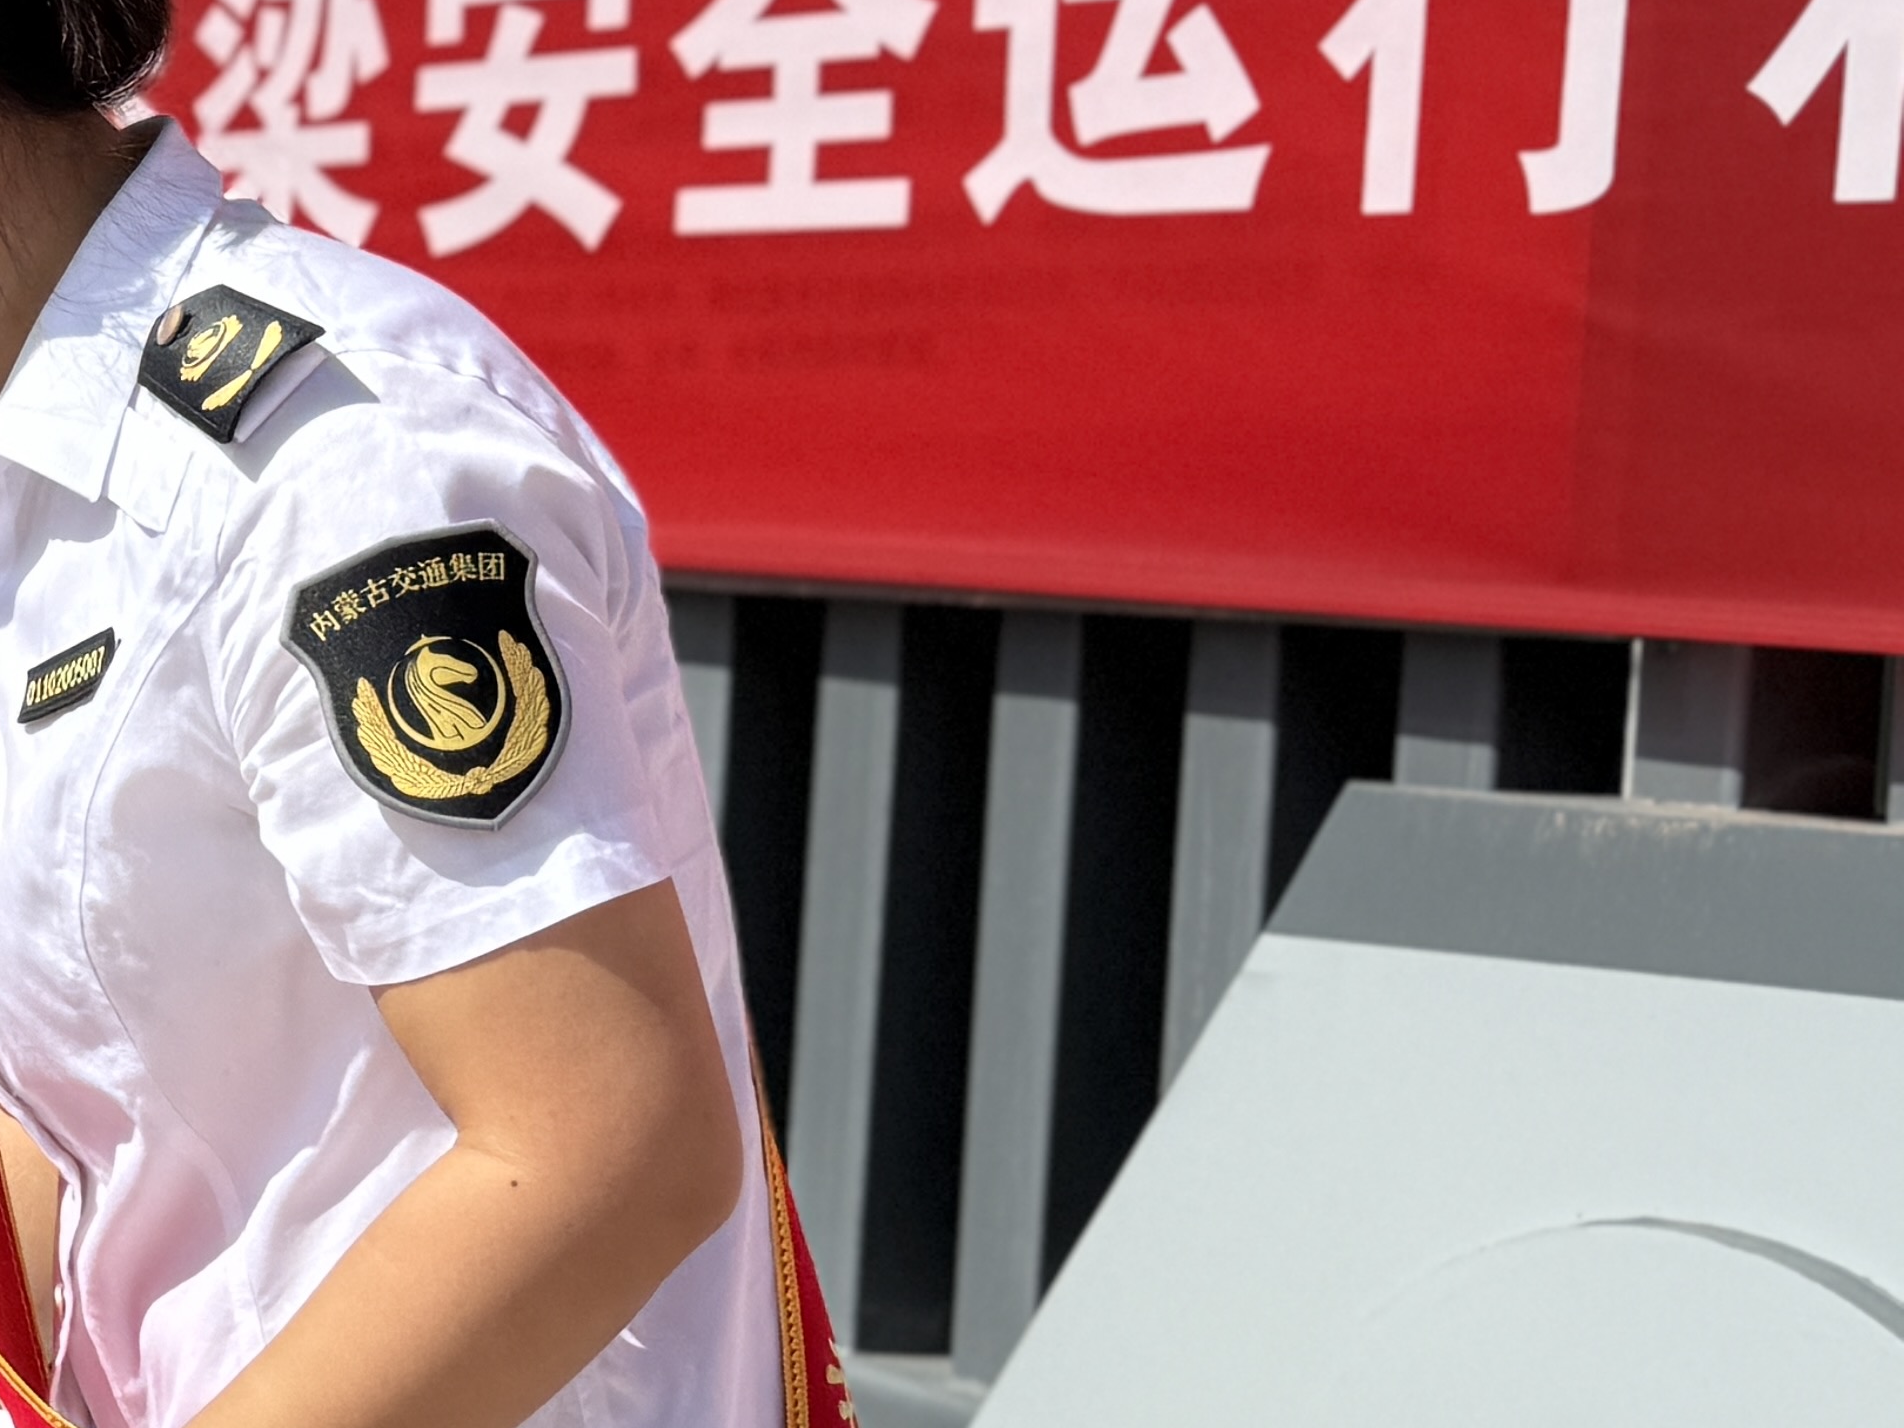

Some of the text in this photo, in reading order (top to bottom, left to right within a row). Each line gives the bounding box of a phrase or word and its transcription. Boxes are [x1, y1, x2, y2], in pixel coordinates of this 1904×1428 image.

[308, 549, 508, 642] 内蒙古交通集团
